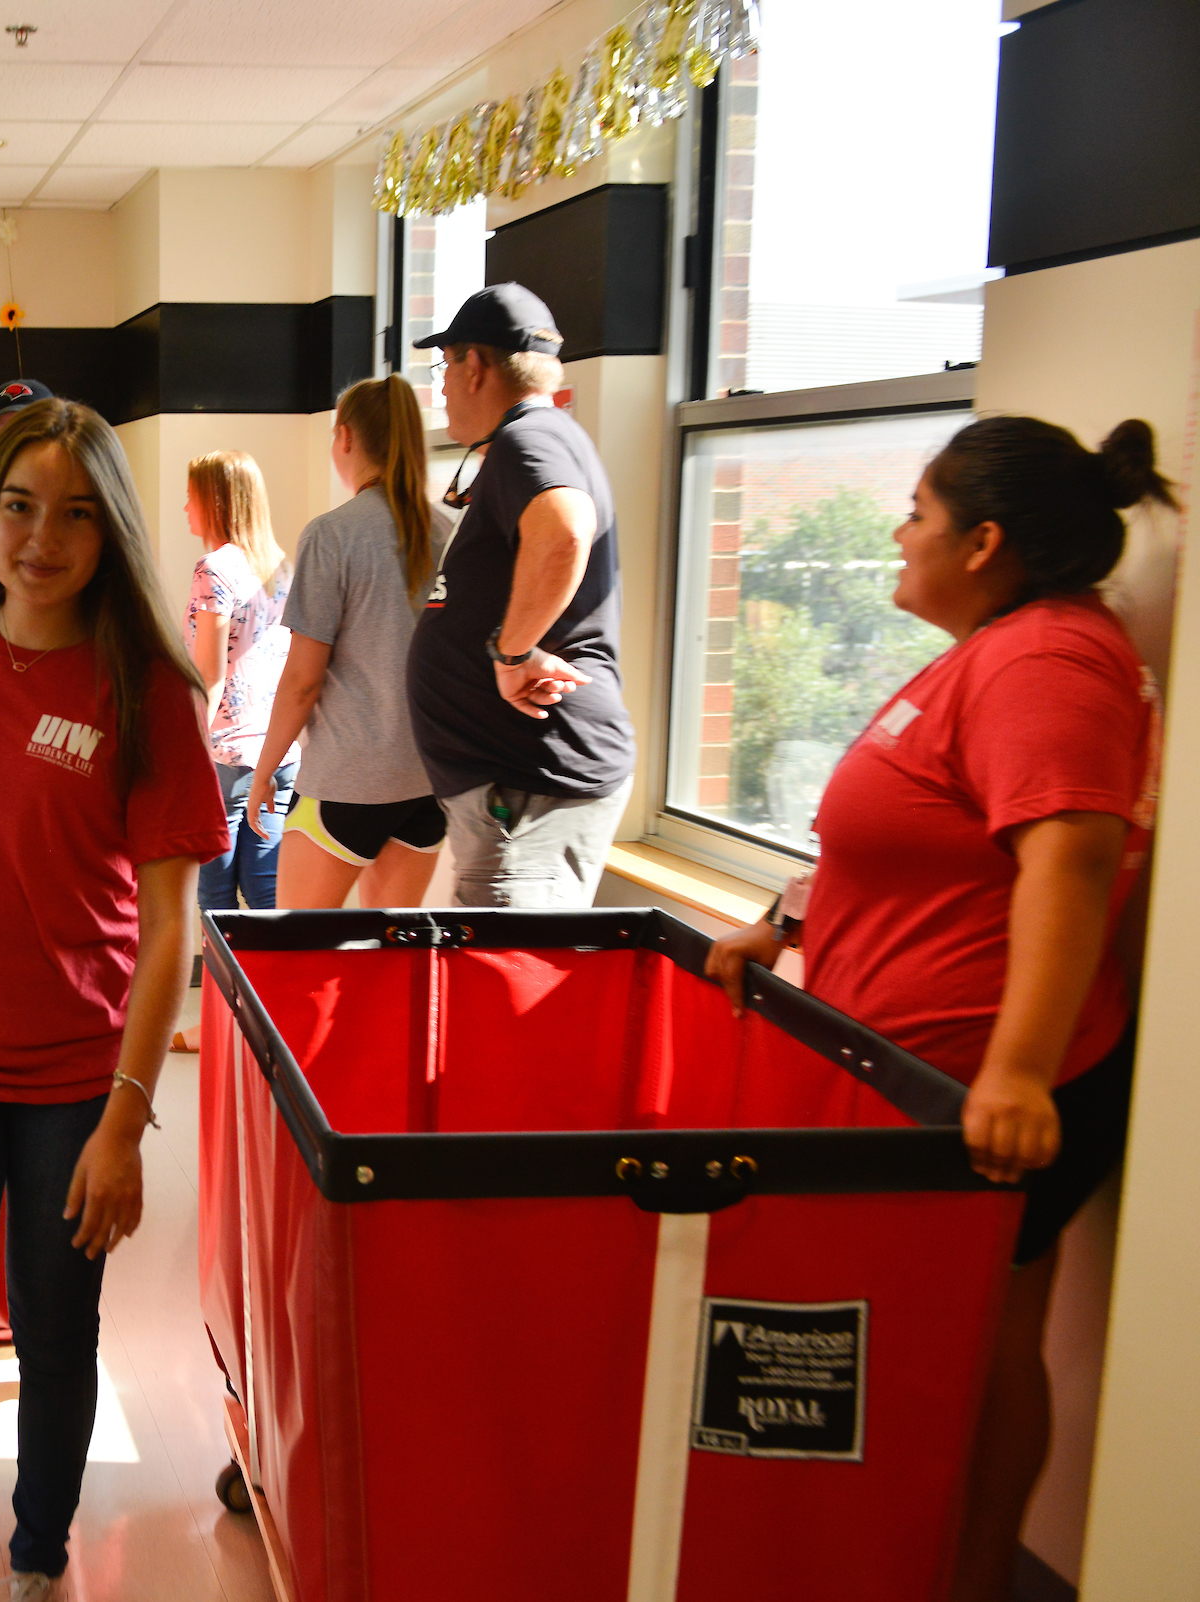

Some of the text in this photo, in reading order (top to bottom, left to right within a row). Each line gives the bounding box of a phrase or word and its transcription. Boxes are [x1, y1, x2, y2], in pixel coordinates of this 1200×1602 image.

[31, 714, 105, 761] UIW
[26, 741, 74, 765] RESIDENCE
[75, 758, 94, 774] LIFE
[748, 1324, 854, 1346] American
[738, 1397, 824, 1431] ROYAL
